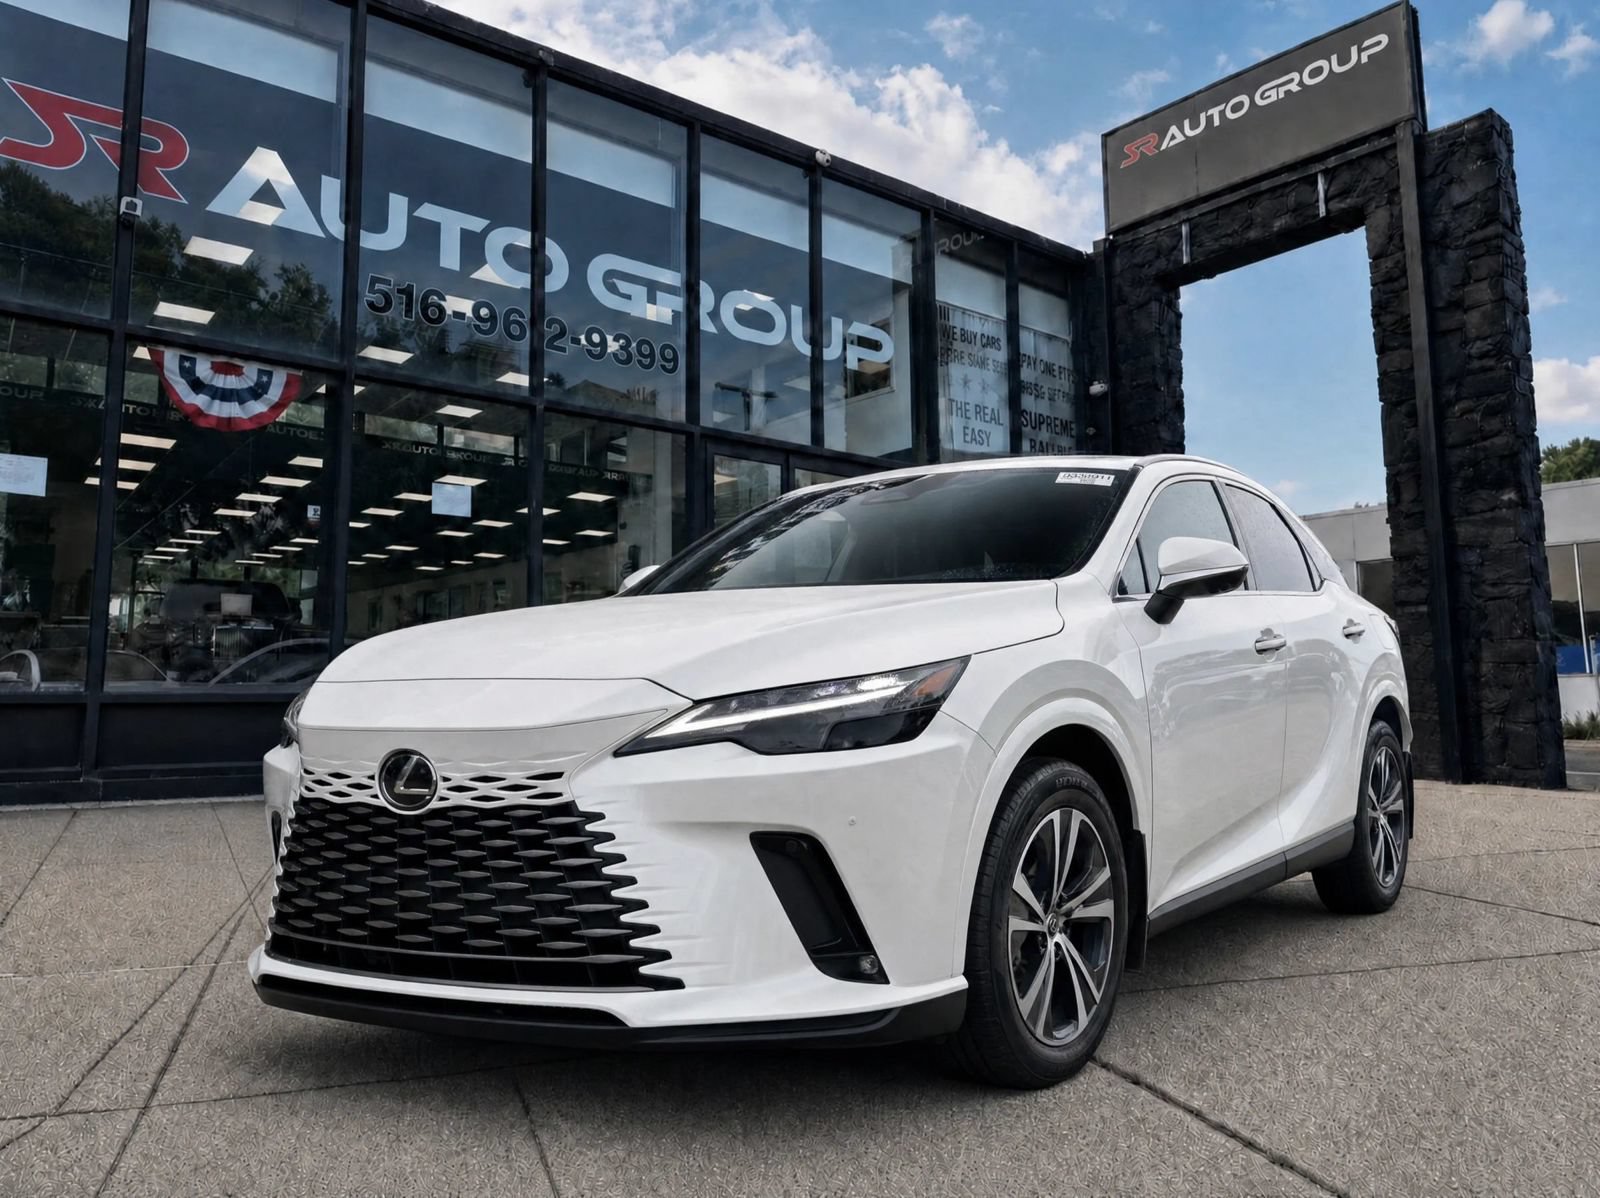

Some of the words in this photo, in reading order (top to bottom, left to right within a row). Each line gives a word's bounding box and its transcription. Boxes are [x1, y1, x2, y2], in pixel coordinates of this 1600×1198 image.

[1119, 132, 1160, 168] SR
[1160, 94, 1250, 151] AUTO
[1254, 33, 1389, 106] GROUP
[206, 146, 569, 292] AUTO
[587, 253, 895, 370] GROUP
[960, 328, 978, 346] BUY
[981, 333, 1002, 352] CARS
[1039, 359, 1057, 378] ONE
[949, 398, 971, 420] THE
[974, 404, 1004, 427] REAL
[1021, 409, 1075, 439] SUPREME
[963, 426, 991, 447] EASY
